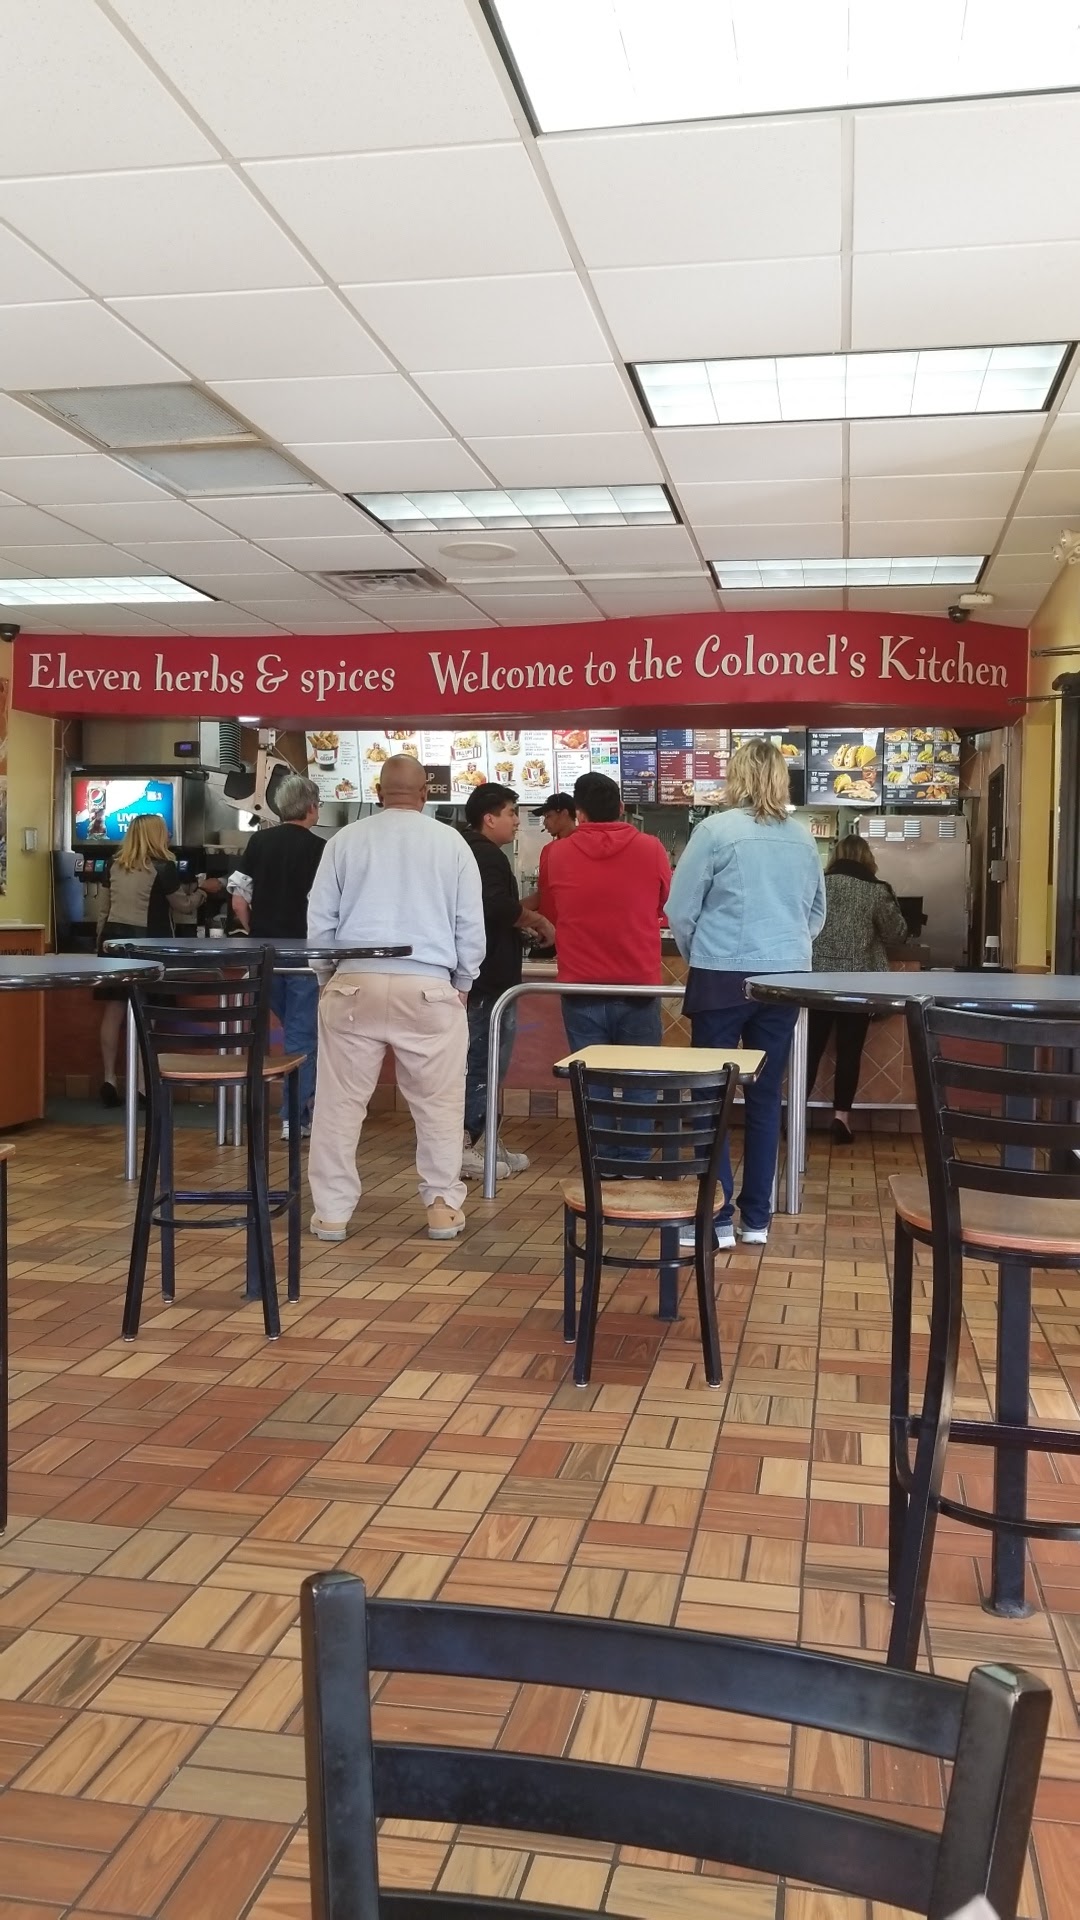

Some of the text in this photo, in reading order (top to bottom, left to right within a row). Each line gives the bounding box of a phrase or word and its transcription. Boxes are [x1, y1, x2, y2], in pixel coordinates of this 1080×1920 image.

[28, 653, 396, 702] Eleven herbs & spices
[428, 633, 1009, 695] Welcome to the Colonel's Kitchen
